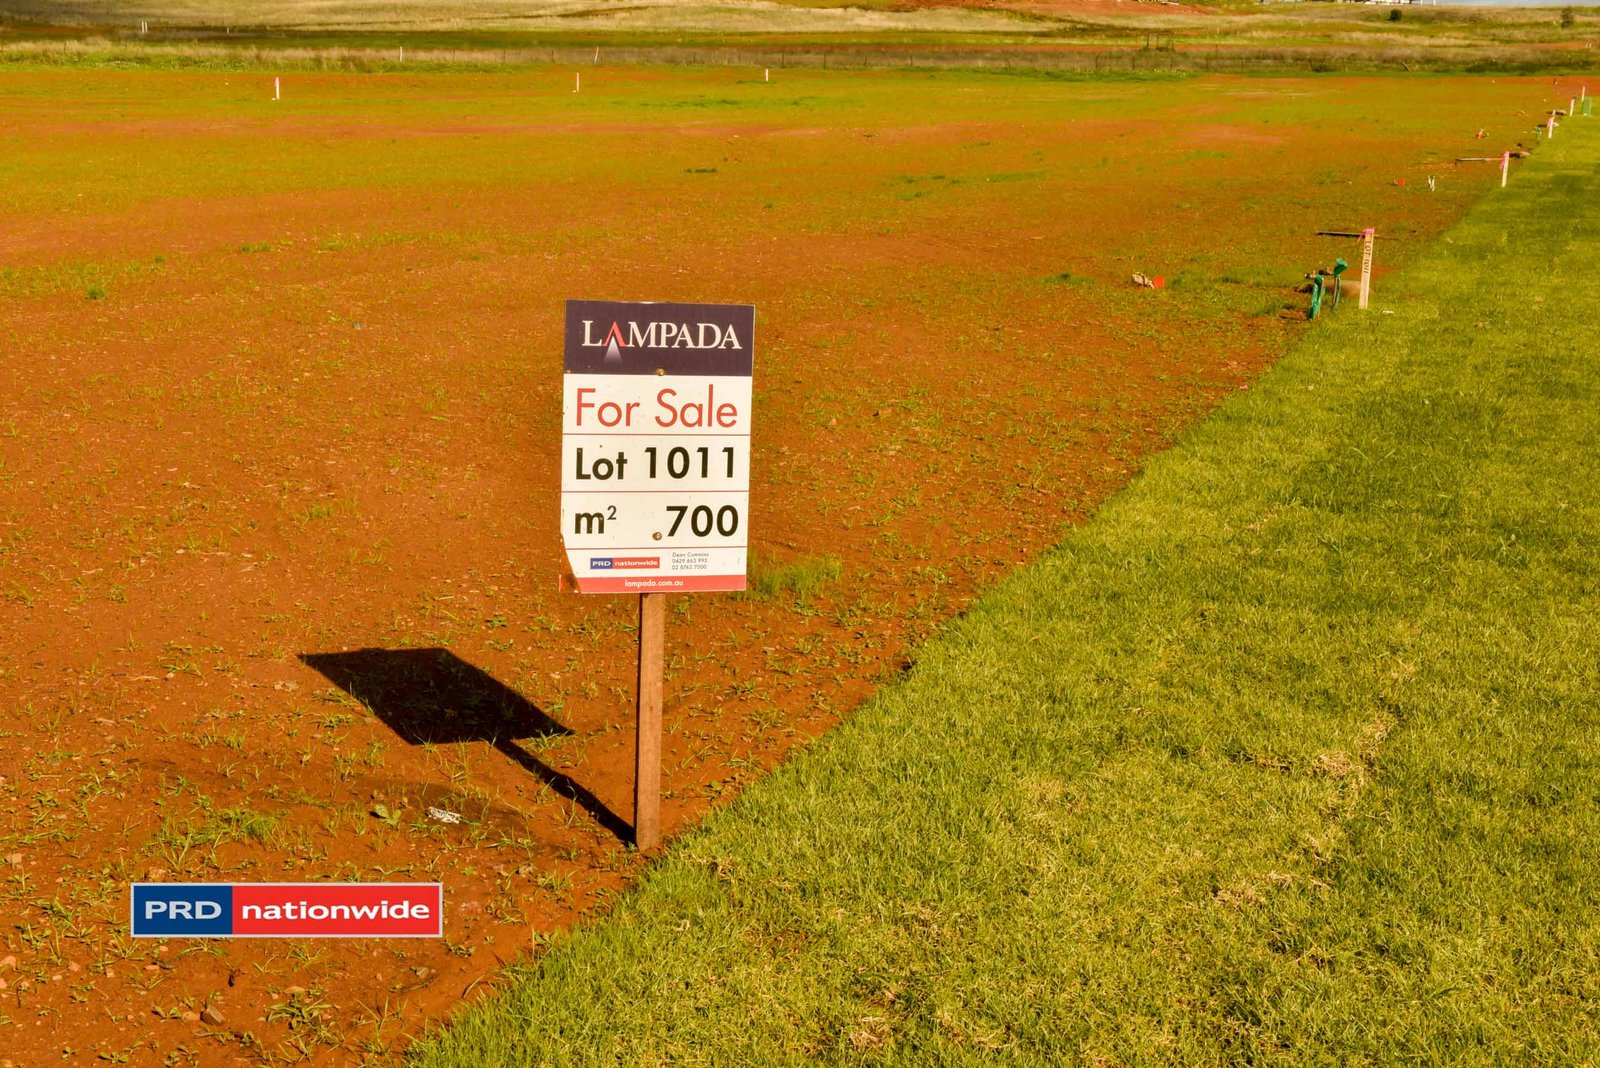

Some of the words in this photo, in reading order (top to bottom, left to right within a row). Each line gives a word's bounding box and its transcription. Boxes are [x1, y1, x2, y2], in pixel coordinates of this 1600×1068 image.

[582, 320, 742, 350] LAMPADA
[576, 388, 640, 426] For
[655, 384, 738, 428] Sale
[575, 447, 628, 480] Lot
[644, 446, 734, 479] 1011
[666, 505, 739, 537] 700
[614, 559, 658, 567] nationwide
[624, 580, 684, 588] lampada.com.au
